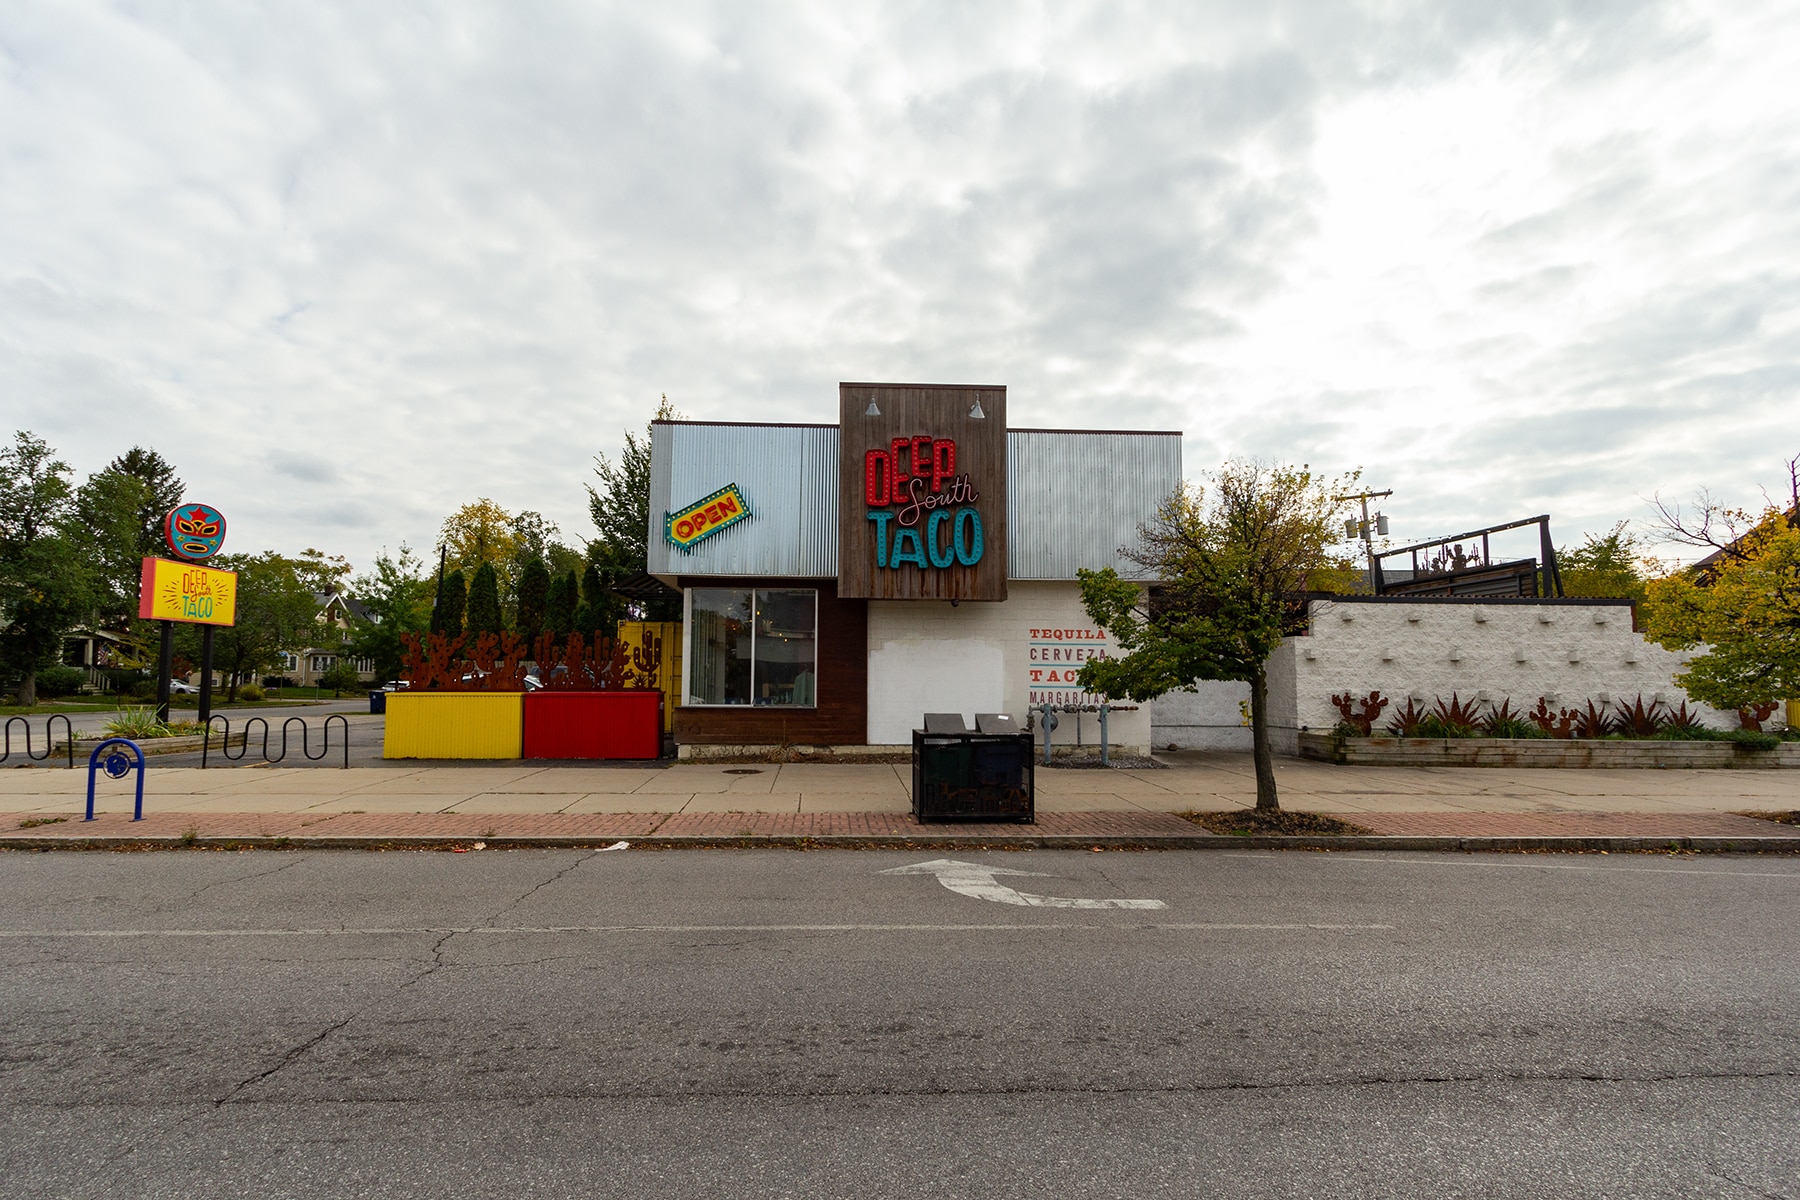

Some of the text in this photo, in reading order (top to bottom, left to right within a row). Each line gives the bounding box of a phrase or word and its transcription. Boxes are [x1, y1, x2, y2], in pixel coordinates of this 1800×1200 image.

[865, 435, 956, 507] DEEP
[898, 473, 979, 526] South
[676, 496, 738, 538] OPEN
[866, 506, 985, 569] TACO
[183, 570, 207, 594] DEEP
[191, 585, 212, 602] South
[183, 596, 212, 618] TACO
[1029, 628, 1107, 641] TEQUILA
[1029, 647, 1107, 661] CERVEZA
[1029, 670, 1078, 682] TAC
